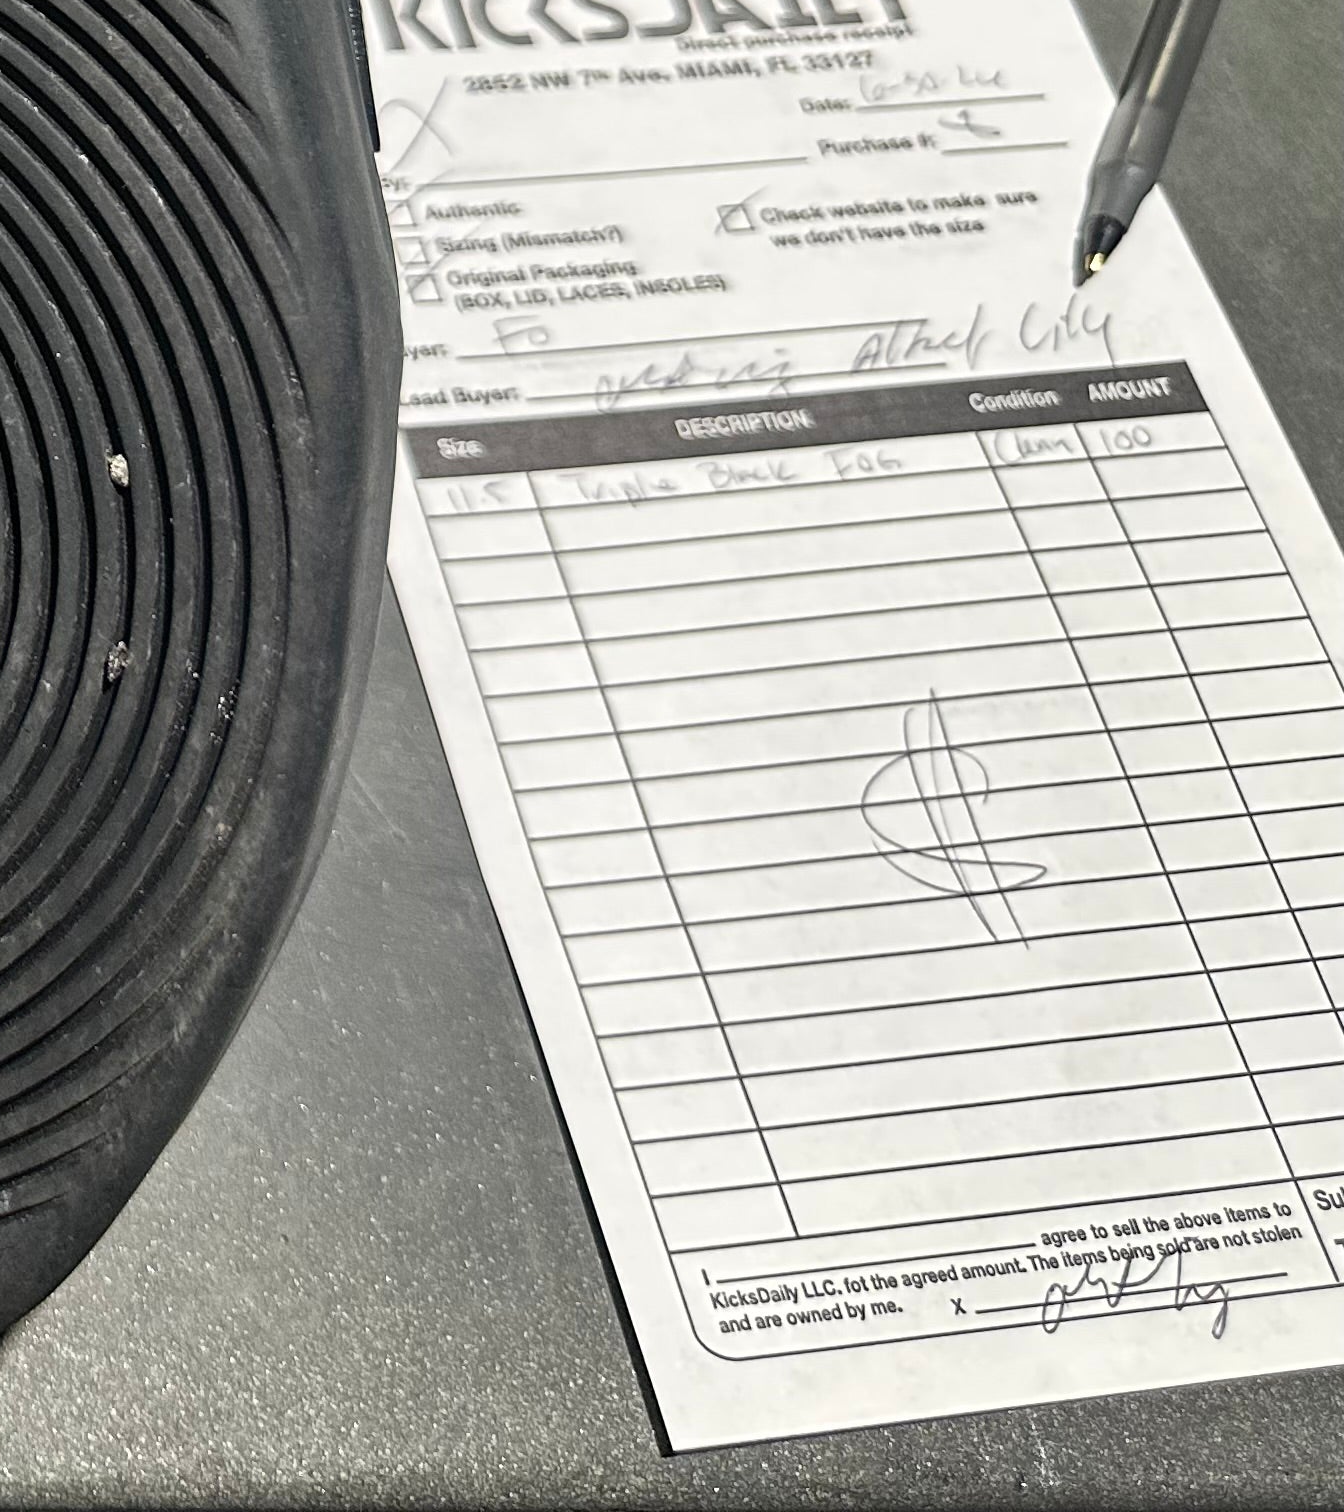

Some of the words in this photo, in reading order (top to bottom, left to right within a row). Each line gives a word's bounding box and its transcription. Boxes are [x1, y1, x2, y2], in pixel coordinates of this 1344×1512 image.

[744, 31, 838, 50] purchase
[528, 70, 572, 89] NW
[766, 55, 798, 73] FL
[801, 49, 874, 71] 33127
[799, 96, 854, 116] Date:
[818, 136, 914, 159] Purchase
[424, 200, 524, 220] Authentic
[761, 206, 824, 226] Check
[828, 199, 906, 219] website
[932, 192, 987, 211] make
[994, 190, 1039, 206] sure
[502, 223, 624, 252] (Mismatch?)
[771, 235, 802, 248] we
[858, 223, 906, 242] have
[910, 219, 942, 237] the
[947, 219, 986, 234] size
[445, 267, 526, 288] Original
[529, 259, 639, 283] Packaging
[451, 386, 520, 405] Buyer:
[968, 389, 1062, 414] Condition
[1087, 377, 1172, 403] AMOUNT
[674, 408, 814, 440] DESCRIPTION
[1040, 1227, 1088, 1250] agree
[1090, 1224, 1109, 1240] to
[1113, 1218, 1141, 1237] sell
[1146, 1215, 1170, 1232] the
[1173, 1209, 1223, 1230] above
[1224, 1203, 1272, 1222] items
[1273, 1202, 1292, 1217] to
[709, 1286, 799, 1310] KicksDaily
[870, 1271, 899, 1290] the
[901, 1263, 959, 1288] agreed
[1027, 1252, 1060, 1272] The
[1061, 1244, 1108, 1267] items
[1110, 1238, 1156, 1263] being
[1158, 1236, 1192, 1256] sold
[1193, 1235, 1222, 1252] are
[1223, 1228, 1251, 1246] not
[1251, 1224, 1304, 1244] stolen
[718, 1317, 753, 1334] and
[755, 1314, 784, 1330] are
[786, 1306, 844, 1326] owned
[844, 1300, 868, 1321] by
[869, 1298, 905, 1316] me.
[949, 1297, 968, 1316] X
